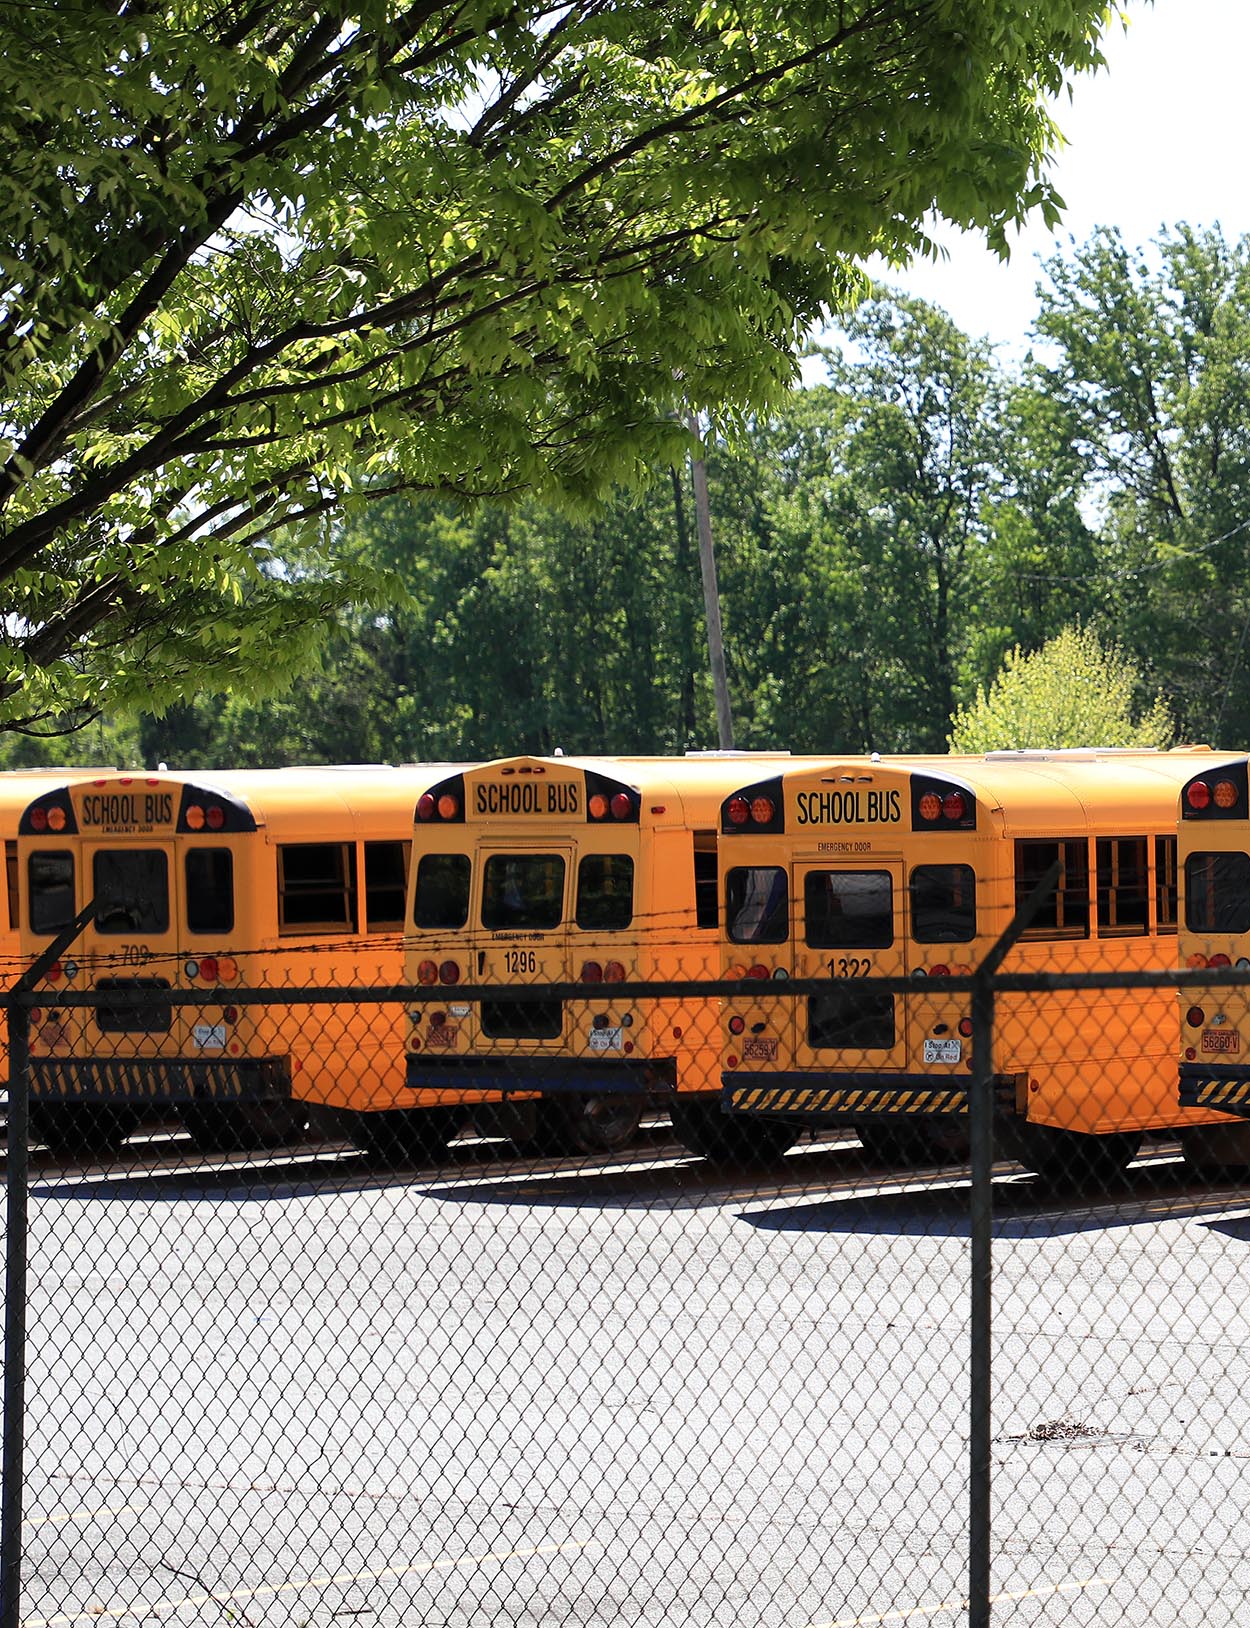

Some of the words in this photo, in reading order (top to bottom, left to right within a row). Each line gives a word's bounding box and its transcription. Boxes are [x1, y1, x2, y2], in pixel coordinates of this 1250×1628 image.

[83, 795, 138, 824] SCHOOL
[145, 794, 172, 824] BUS
[477, 784, 542, 813] SCHOOL
[548, 784, 577, 812] BUS
[797, 791, 865, 824] SCHOOL
[868, 790, 900, 822] BUS
[817, 843, 853, 851] EMERGENCY
[854, 842, 871, 851] DOOR
[504, 951, 536, 973] 1296
[827, 958, 871, 978] 1322
[928, 1040, 941, 1050] Stop
[1203, 1035, 1237, 1049] 56260-V
